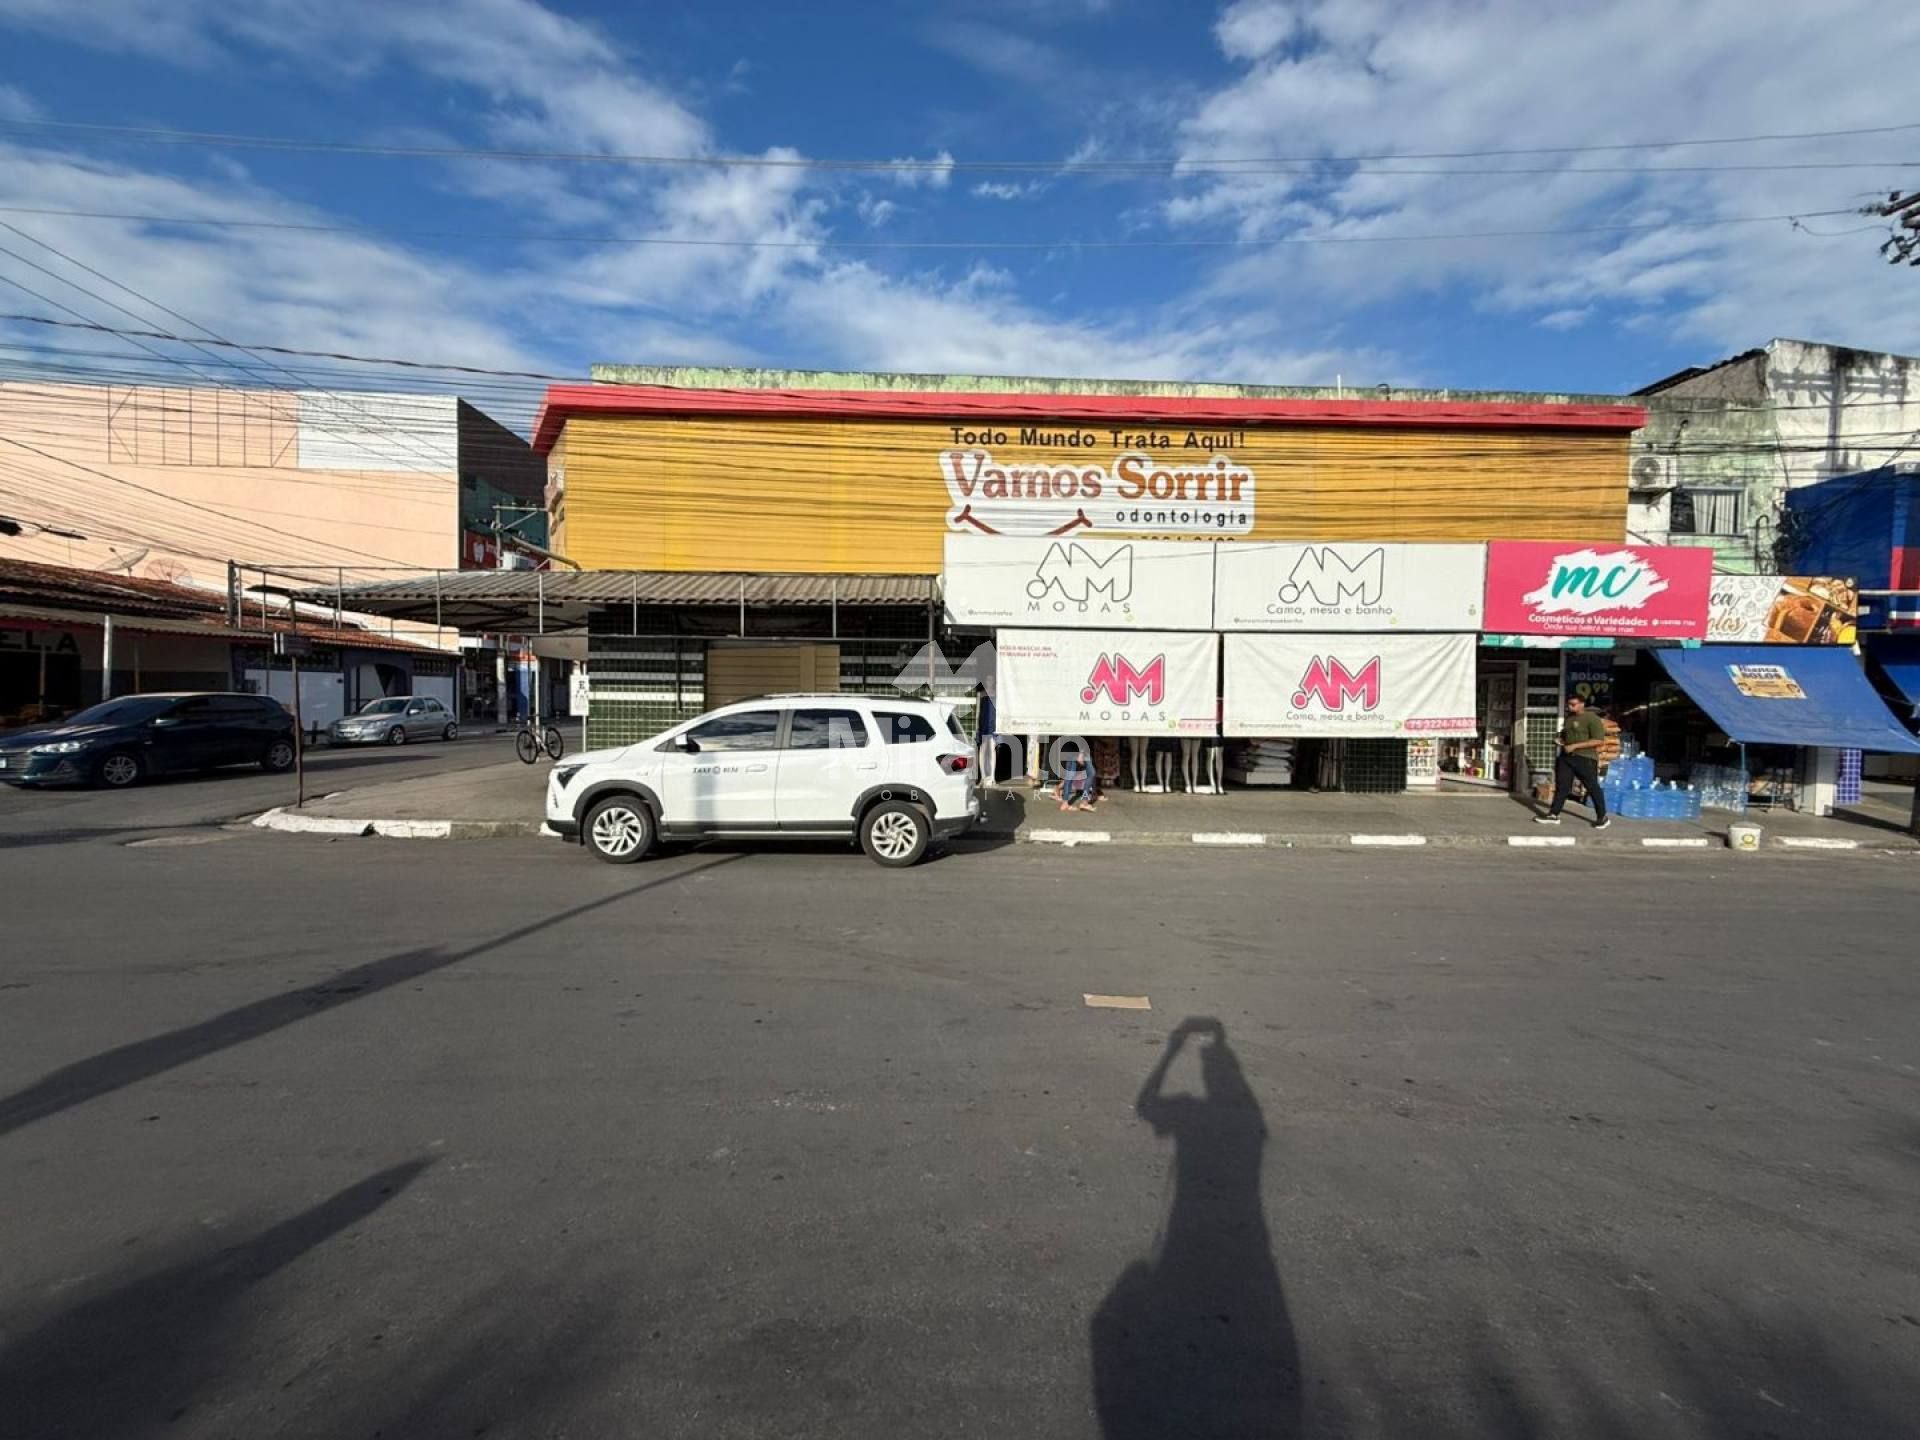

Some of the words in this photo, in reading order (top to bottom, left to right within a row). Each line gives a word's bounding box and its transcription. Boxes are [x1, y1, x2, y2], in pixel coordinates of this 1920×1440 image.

[951, 428, 1007, 445] Todo
[1020, 429, 1096, 447] Mundo
[1109, 430, 1170, 448] Trata
[950, 454, 1101, 498] Vamos
[1116, 457, 1249, 501] Sorrir
[1116, 508, 1247, 527] odontologia
[1027, 602, 1131, 613] MODAS
[1310, 606, 1341, 615] mesa
[1344, 607, 1351, 615] e
[1356, 604, 1393, 616] banho
[1593, 616, 1649, 627] Variedades
[1079, 711, 1166, 721] MODAS
[1319, 713, 1344, 721] mesa
